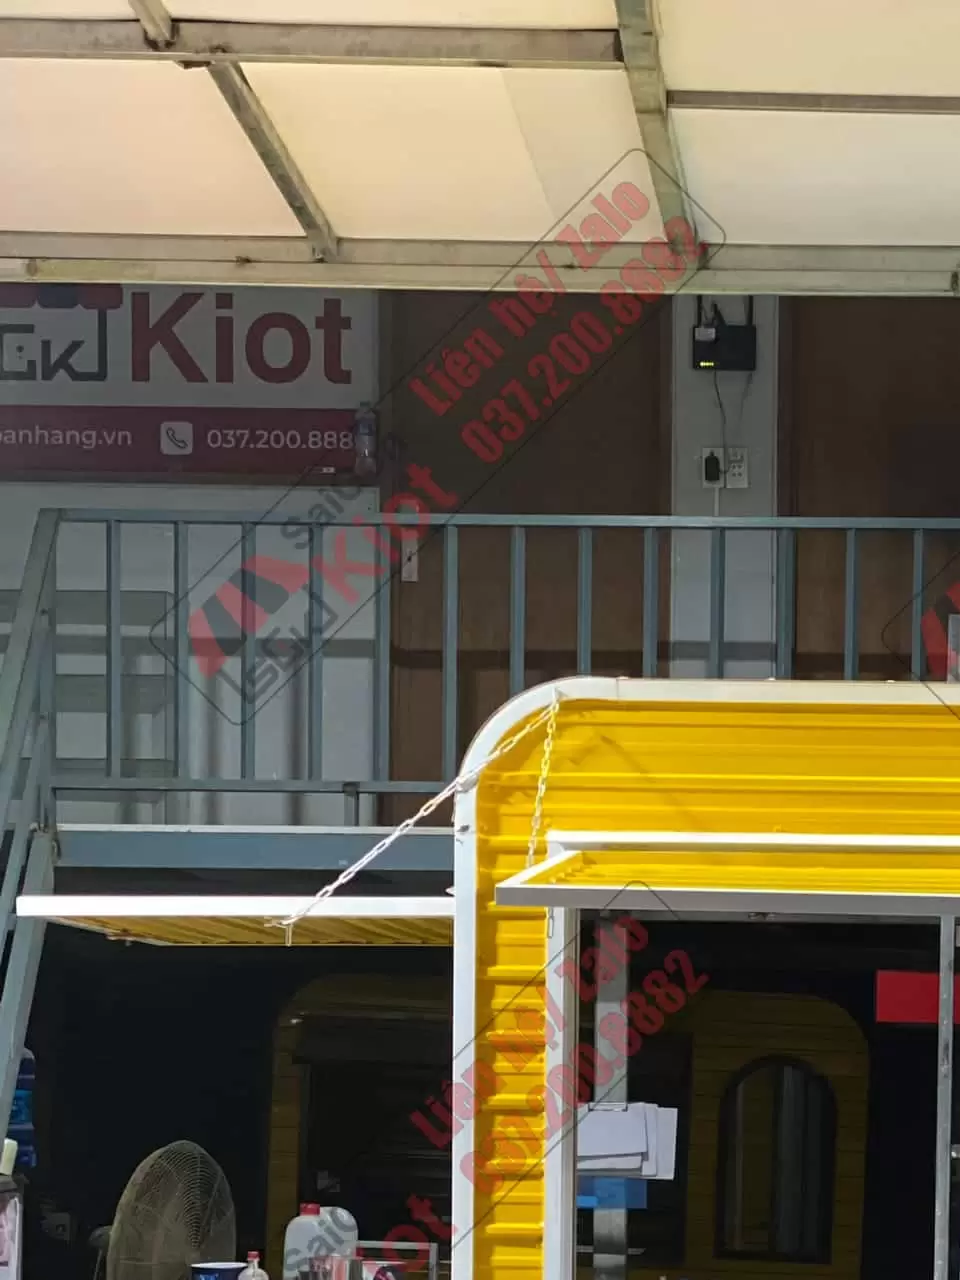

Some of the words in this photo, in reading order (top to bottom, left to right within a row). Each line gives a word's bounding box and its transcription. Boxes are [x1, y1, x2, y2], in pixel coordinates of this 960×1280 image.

[131, 290, 353, 385] Kiot
[0, 424, 133, 449] anhang.vn
[207, 429, 356, 449] 037.200.888
